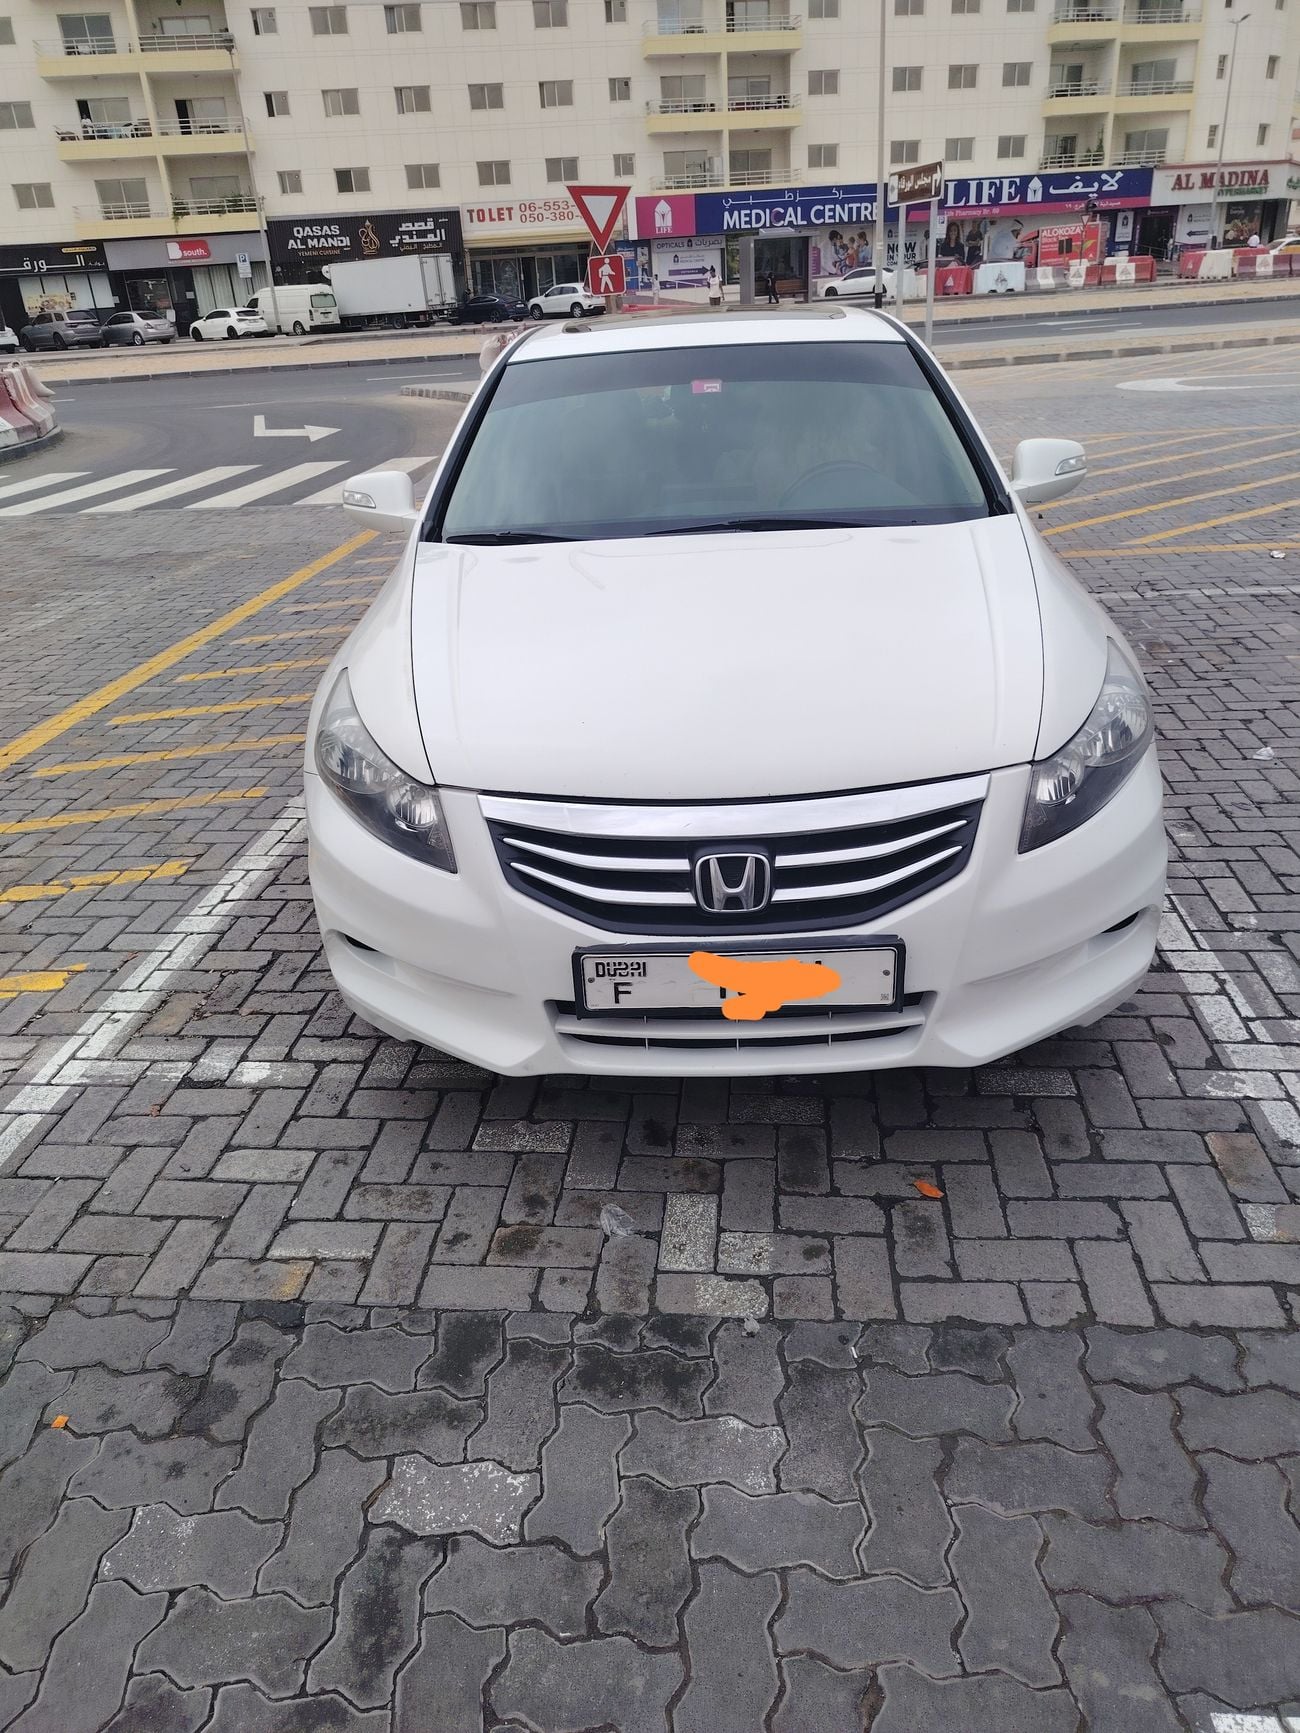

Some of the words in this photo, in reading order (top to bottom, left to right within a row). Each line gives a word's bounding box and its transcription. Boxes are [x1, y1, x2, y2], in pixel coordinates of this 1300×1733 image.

[1049, 171, 1124, 198] لايف
[1171, 173, 1196, 191] AL
[1199, 169, 1270, 190] MADINA
[944, 177, 1021, 207] LIFE
[399, 217, 435, 231] قصص
[723, 206, 807, 230] MEDICAL
[293, 225, 340, 238] QASAS
[389, 228, 446, 248] المندي
[655, 226, 673, 234] LIFE
[288, 239, 306, 250] AL
[307, 236, 351, 249] MANDI
[656, 241, 685, 249] OPTICALS
[595, 961, 647, 978] DUBAI
[613, 982, 633, 1004] F
